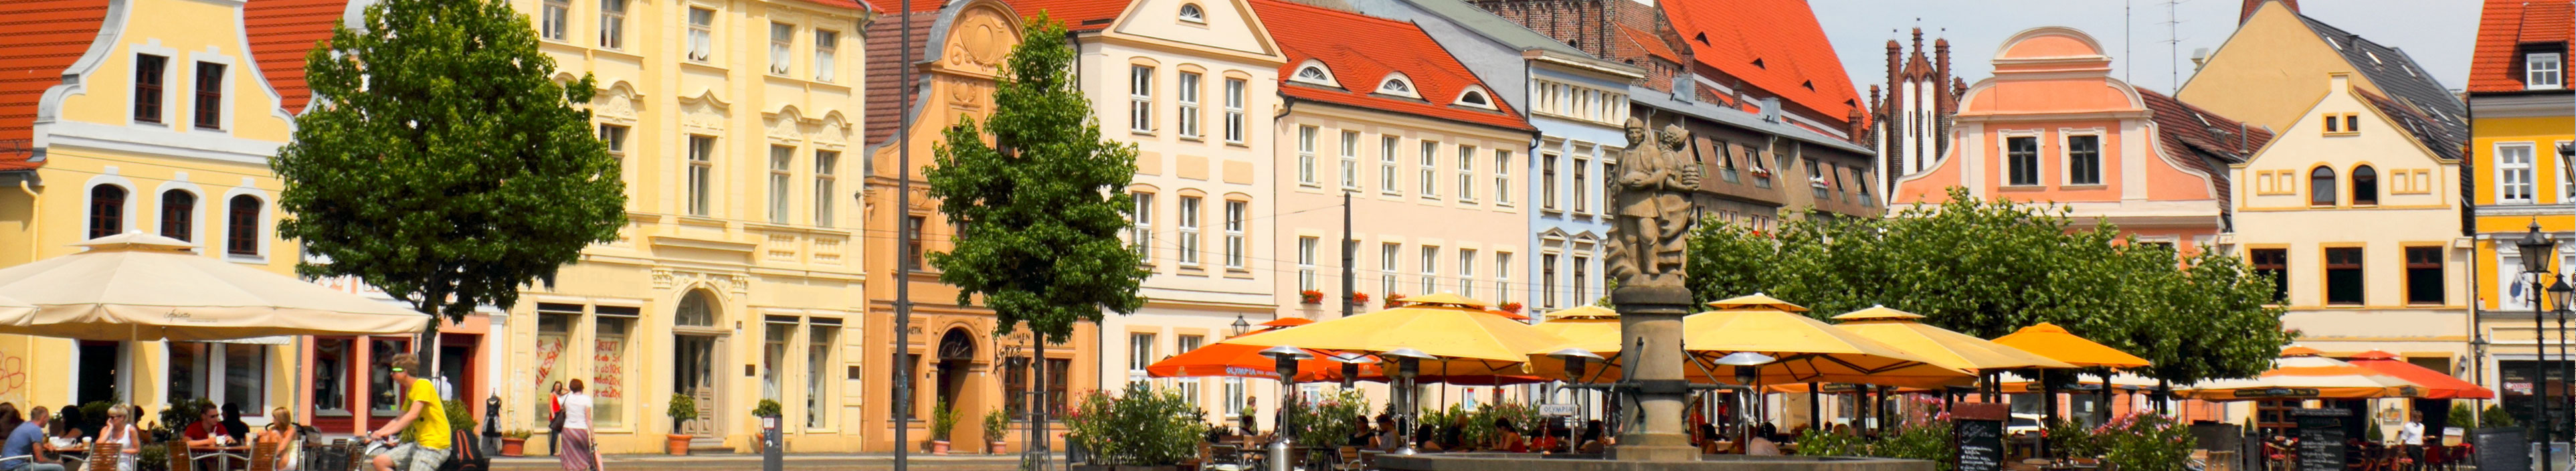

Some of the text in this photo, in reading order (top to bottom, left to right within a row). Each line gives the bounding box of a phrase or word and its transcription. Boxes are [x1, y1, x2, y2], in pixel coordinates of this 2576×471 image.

[894, 326, 922, 335] KMETIK
[595, 339, 618, 353] JETZT
[601, 354, 609, 362] ab
[601, 363, 609, 373] ab
[1226, 367, 1256, 376] OLYMPIA
[602, 376, 609, 384] ab
[601, 387, 609, 397] ab
